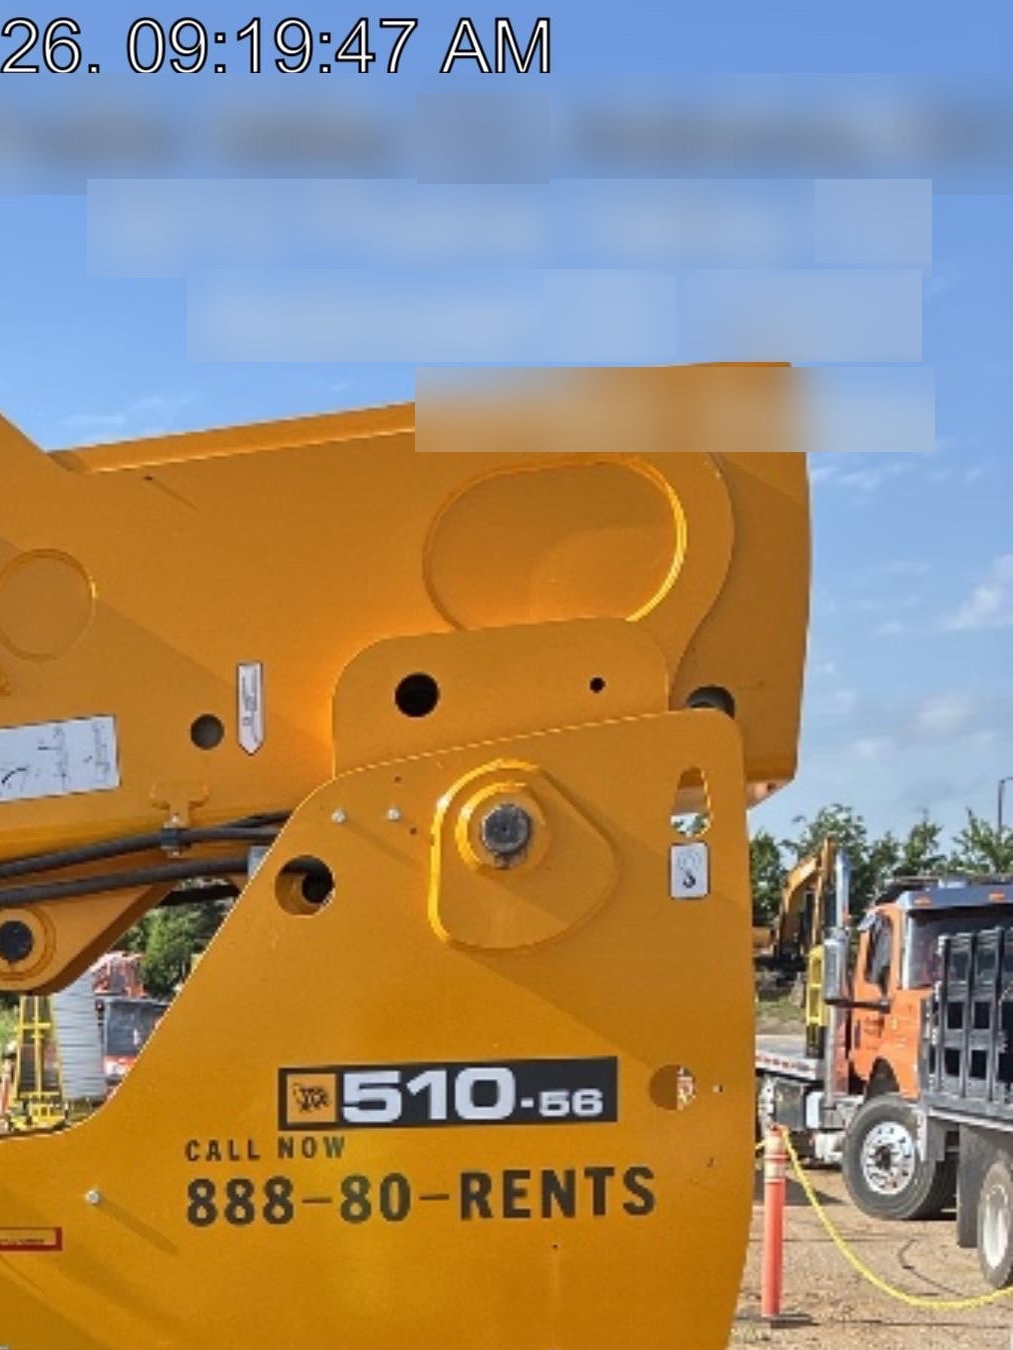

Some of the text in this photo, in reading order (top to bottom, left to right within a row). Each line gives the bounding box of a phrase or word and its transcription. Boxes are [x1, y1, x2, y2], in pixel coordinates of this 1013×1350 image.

[341, 1066, 605, 1124] 510-56
[184, 1135, 346, 1162] CALL NOW
[186, 1165, 657, 1227] 888-80-RENTS
